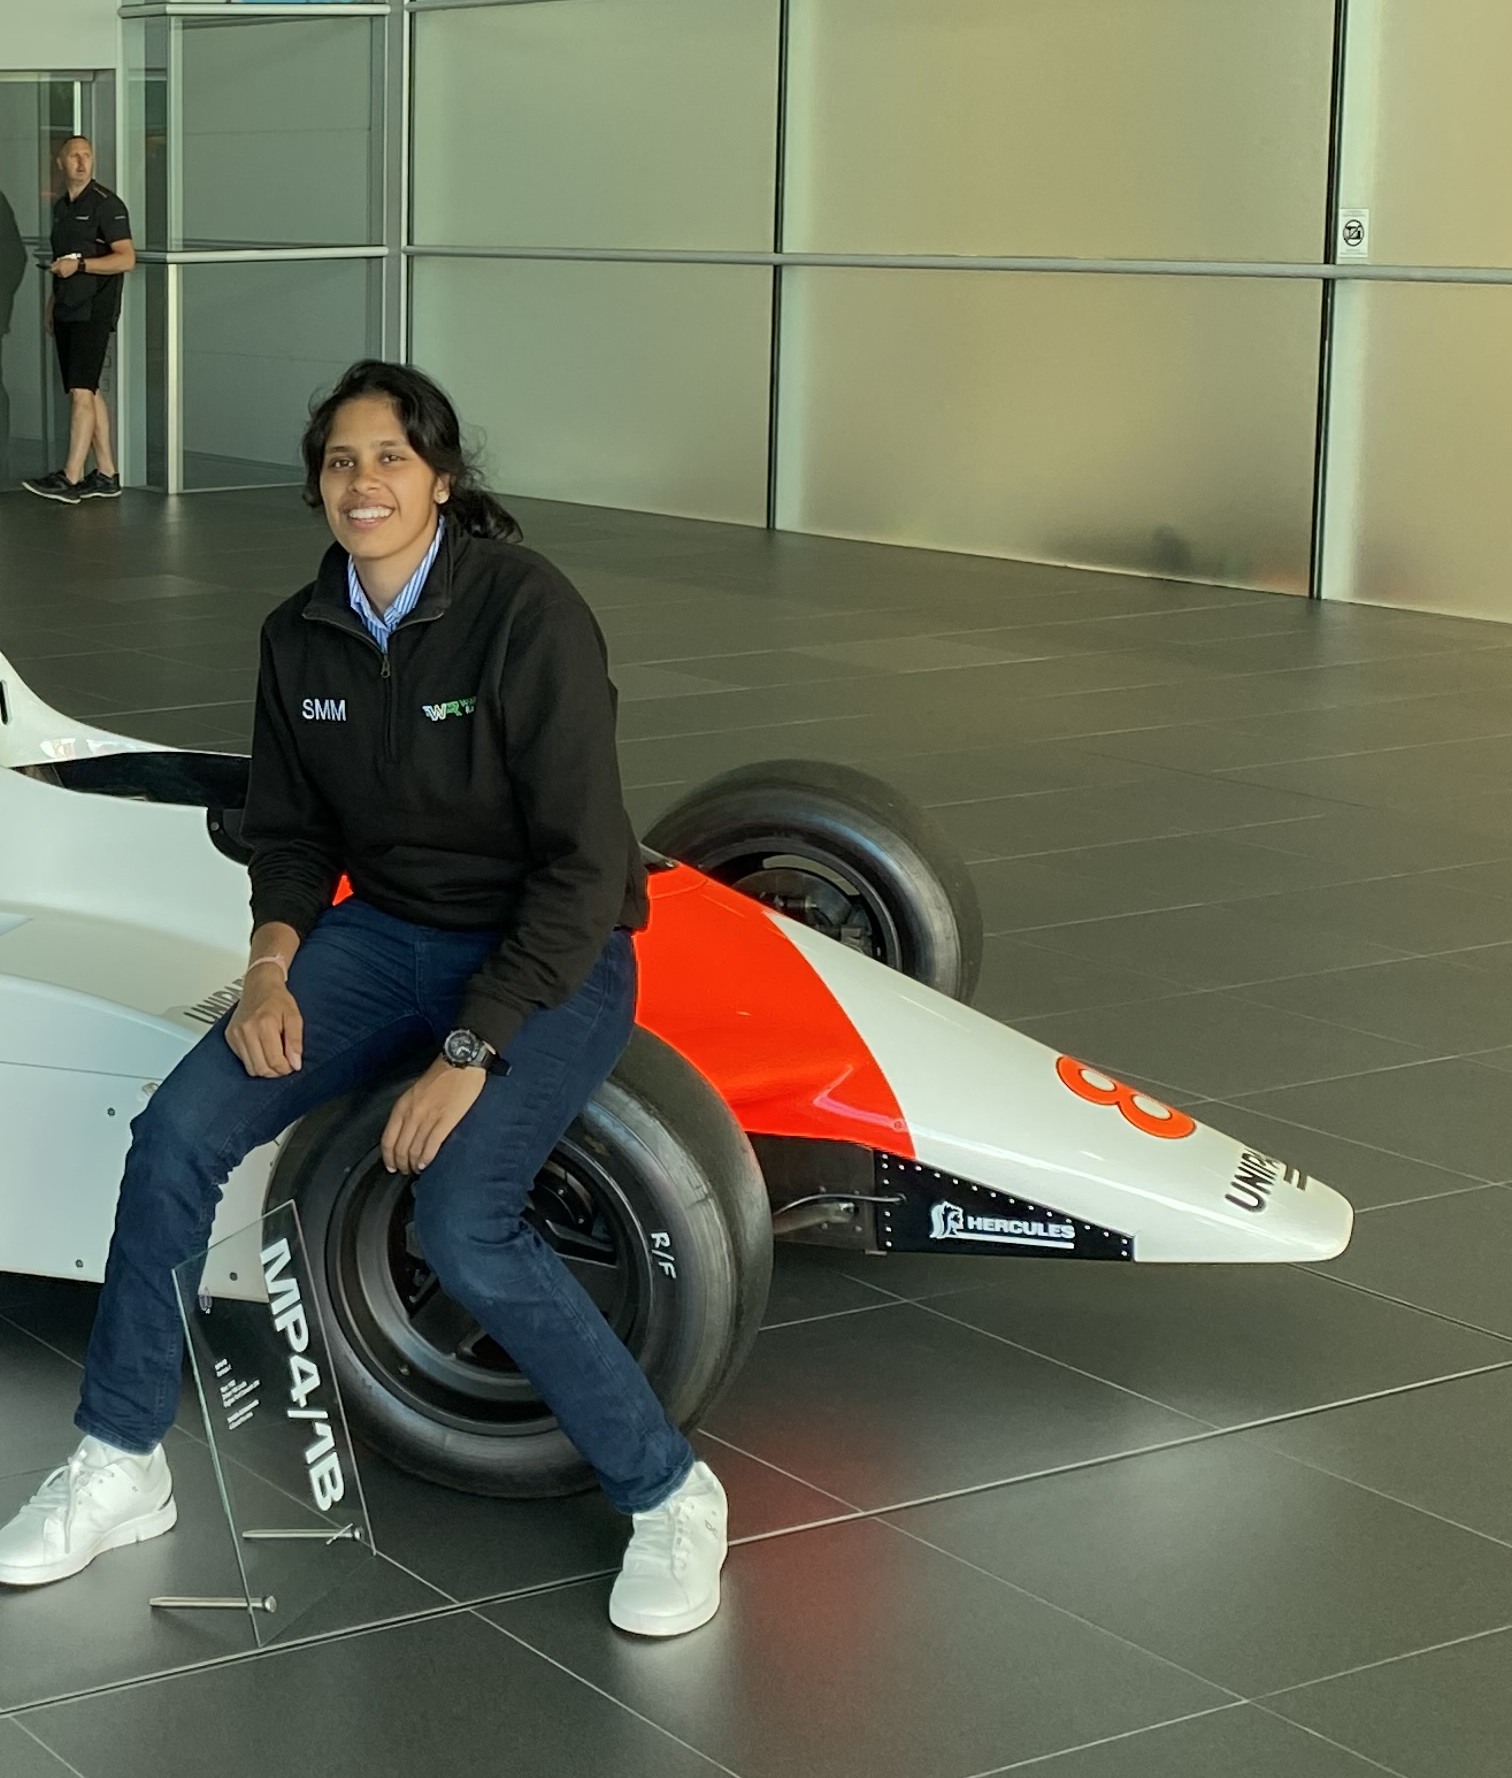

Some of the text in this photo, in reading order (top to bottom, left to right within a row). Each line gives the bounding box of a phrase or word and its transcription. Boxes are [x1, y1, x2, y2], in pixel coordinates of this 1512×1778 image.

[302, 699, 347, 722] SMM
[1056, 1055, 1197, 1139] 8
[967, 1206, 1076, 1239] HERCULES
[650, 1232, 677, 1279] R/F
[260, 1237, 345, 1512] MP4/1B
